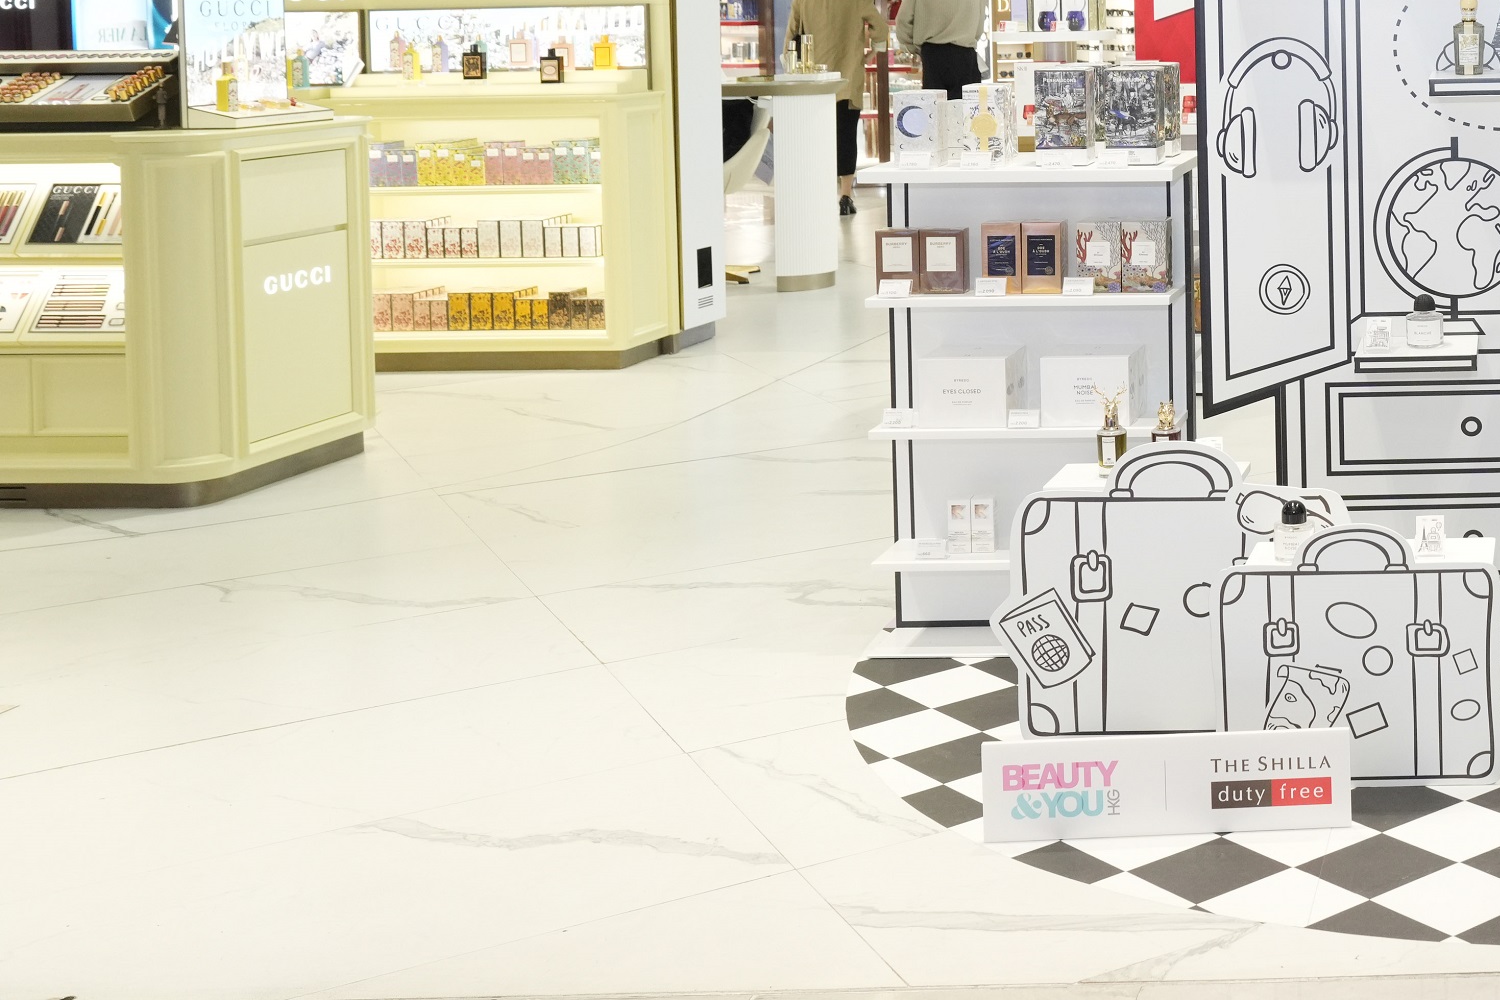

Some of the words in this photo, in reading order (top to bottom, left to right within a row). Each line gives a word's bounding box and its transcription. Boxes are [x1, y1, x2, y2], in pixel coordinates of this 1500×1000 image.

[200, 0, 272, 18] GUCCI
[52, 185, 100, 194] GUCCI
[263, 265, 332, 295] GUCCI
[1016, 613, 1051, 638] PASS
[1002, 760, 1119, 792] BEAUTY
[1210, 758, 1250, 773] THE
[1257, 755, 1332, 772] SHILLA
[1010, 789, 1104, 821] &YOU
[1107, 788, 1121, 816] HKG
[1218, 786, 1266, 805] duty
[1279, 783, 1324, 800] free
